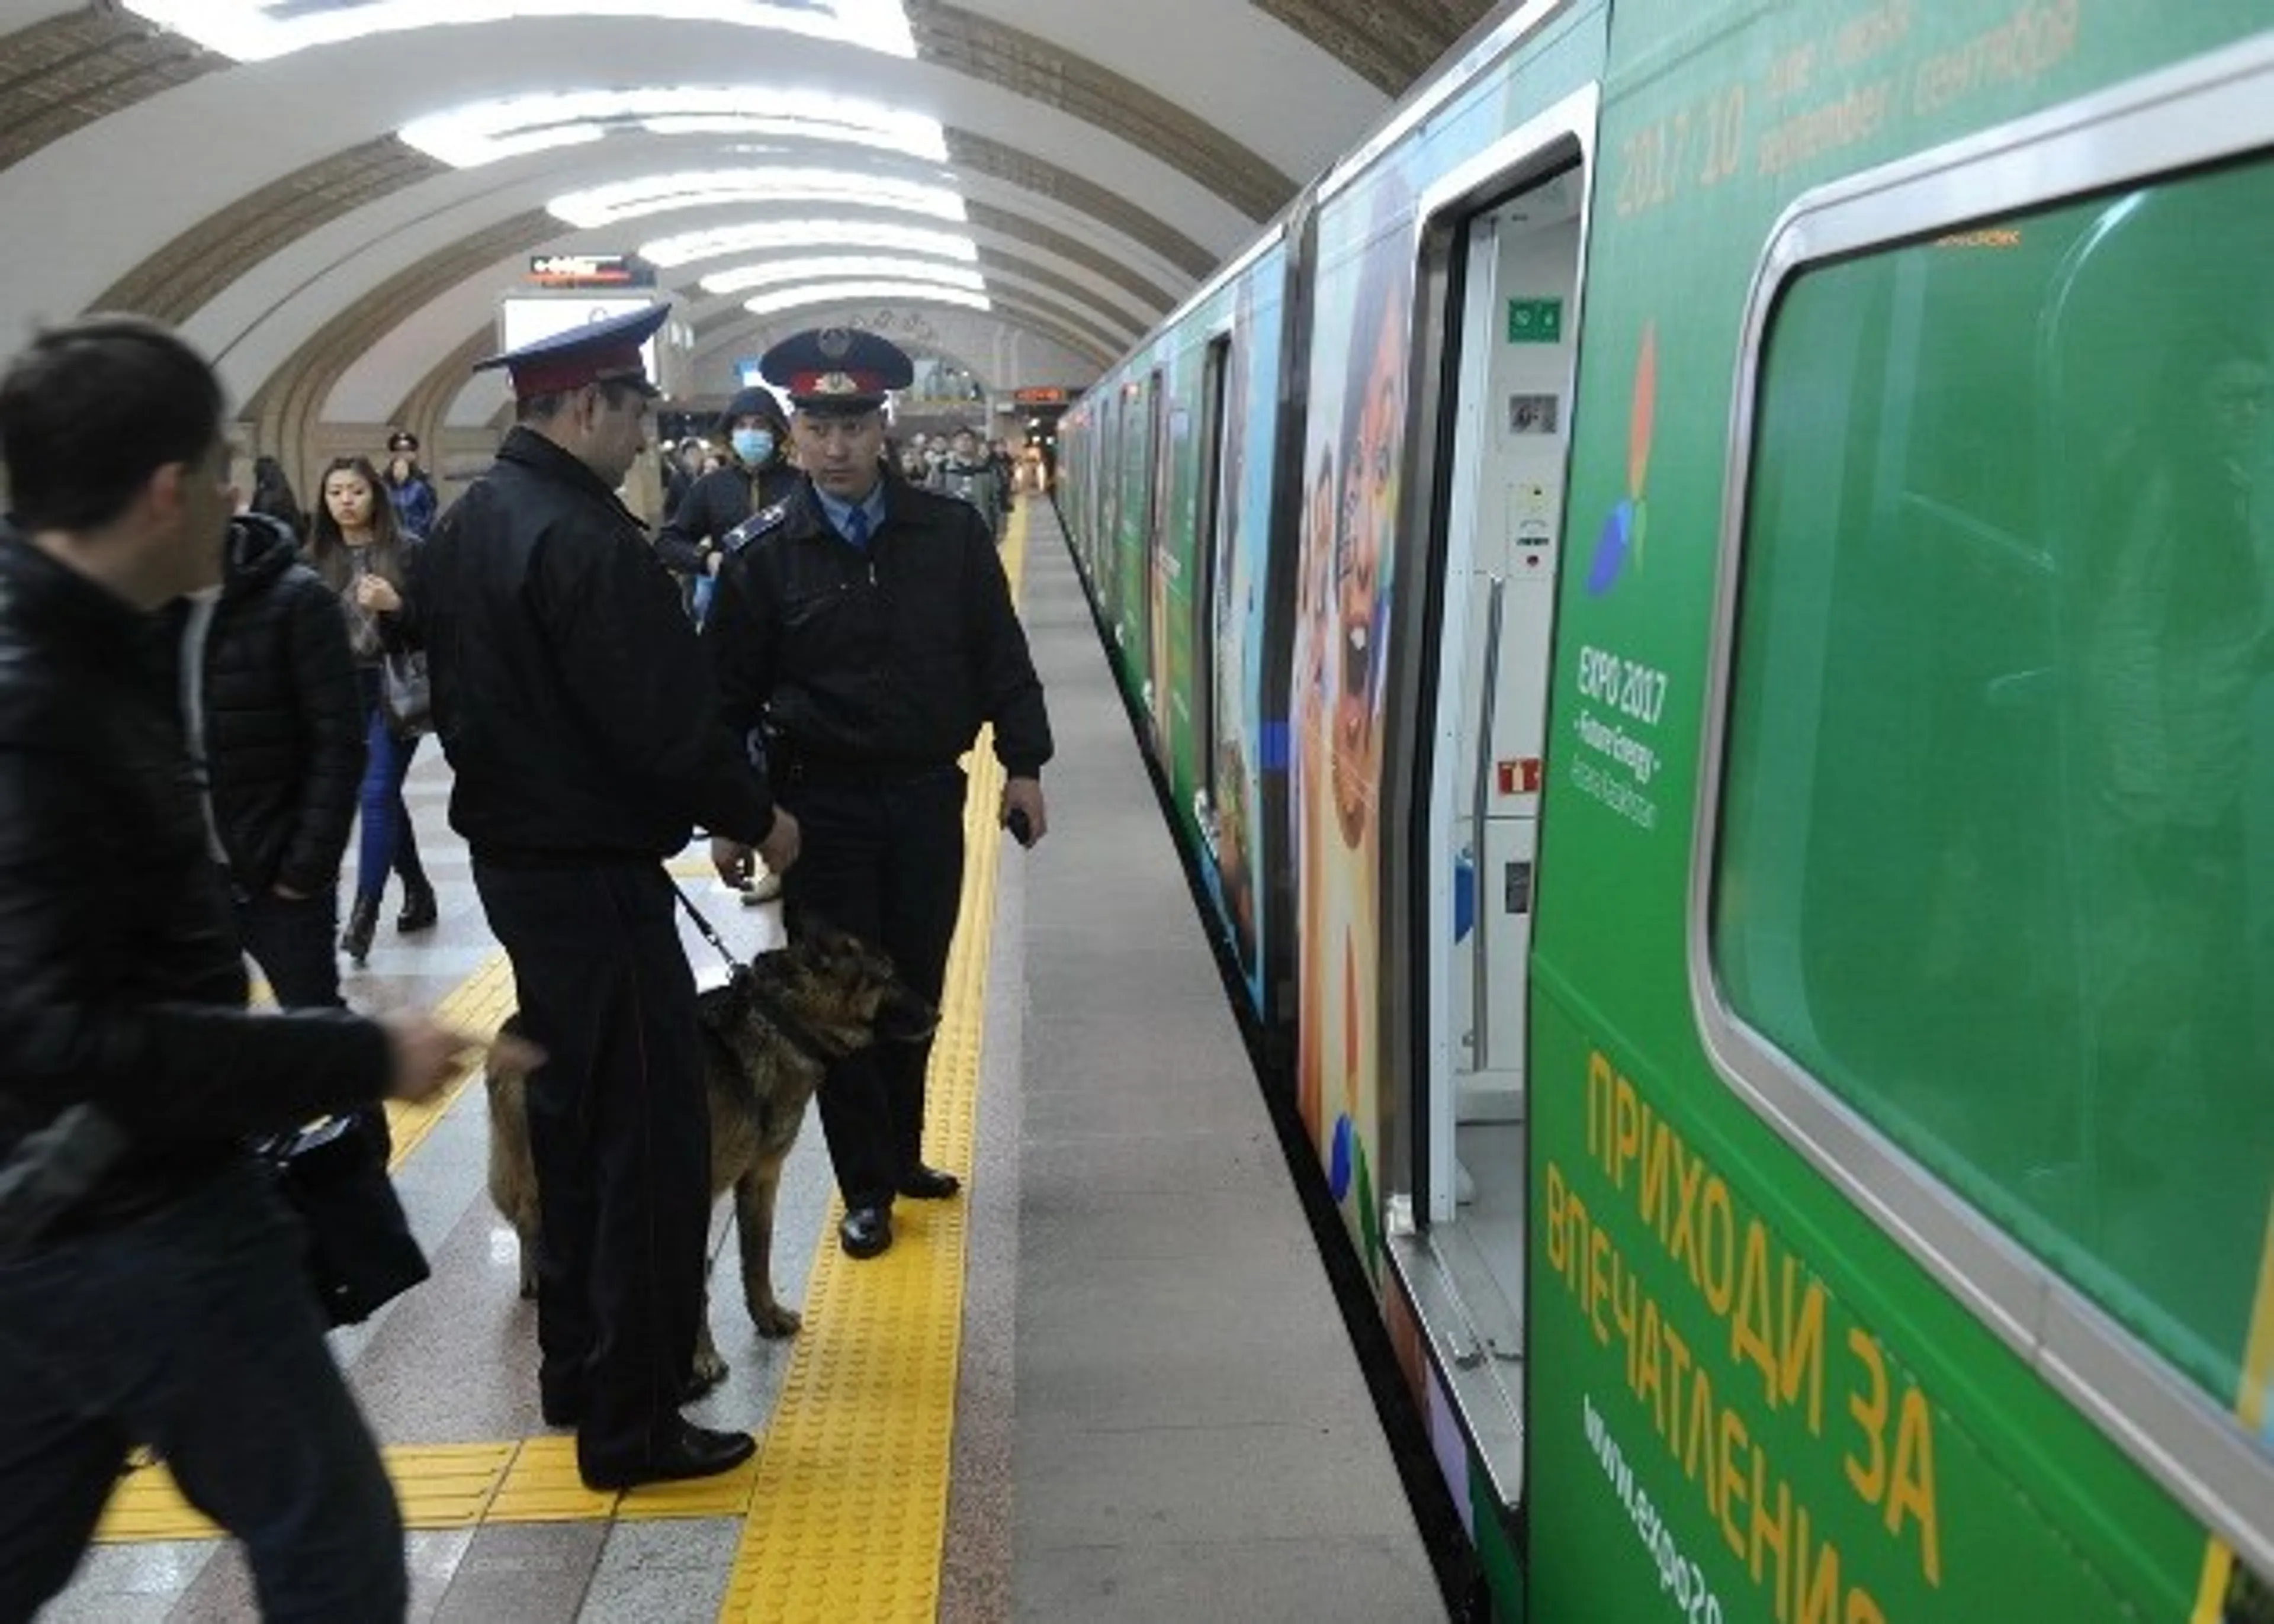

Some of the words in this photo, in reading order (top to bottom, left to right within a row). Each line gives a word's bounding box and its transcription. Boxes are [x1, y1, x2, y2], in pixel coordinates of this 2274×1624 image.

[1577, 647, 1620, 705] EXPO
[1621, 661, 1667, 725] 2017
[1547, 1163, 1888, 1624] ВПЕЧАТЛЕНИ
[1589, 1050, 1825, 1436] ПРИХОДИ
[1845, 1327, 1941, 1588] ЗА
